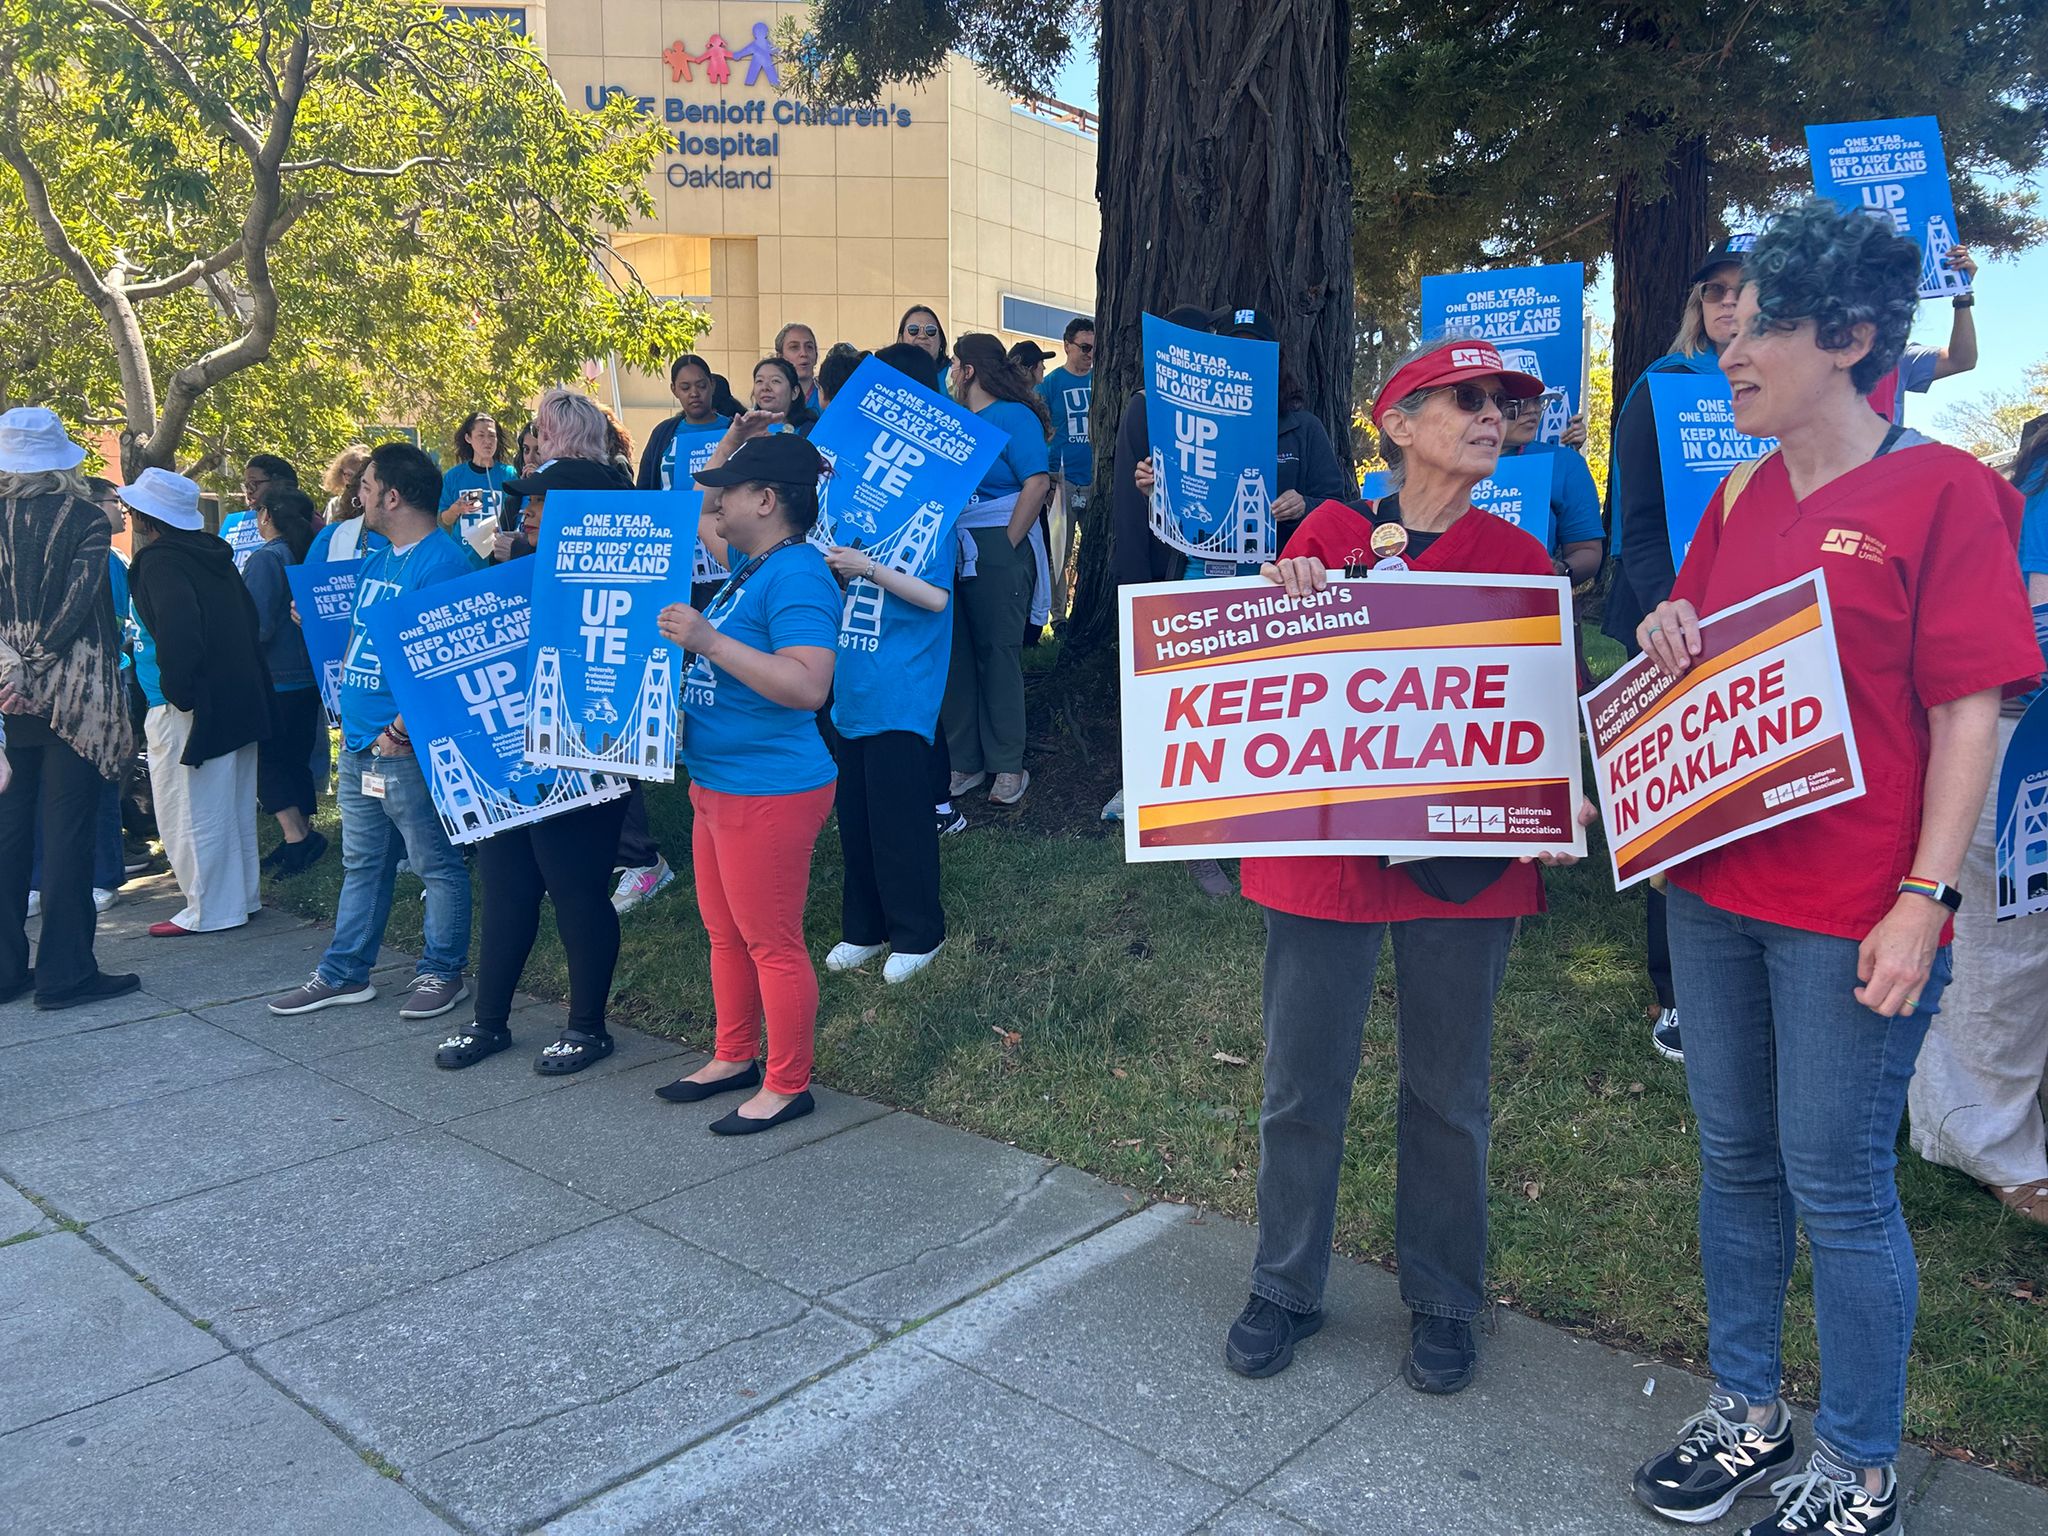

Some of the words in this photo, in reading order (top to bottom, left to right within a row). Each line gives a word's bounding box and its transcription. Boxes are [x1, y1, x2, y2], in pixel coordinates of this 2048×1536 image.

[585, 85, 656, 122] UF
[665, 98, 765, 124] Benioff
[1844, 137, 1868, 147] ONE
[1870, 134, 1904, 144] YEAR.
[1849, 145, 1881, 154] BRIDGE
[1830, 156, 1859, 167] KEEP
[1861, 153, 1892, 164] KIDS'
[1894, 150, 1925, 161] CARE
[1832, 166, 1848, 178] IN
[1851, 159, 1927, 176] OAKLAND
[667, 164, 772, 189] Oakland
[1861, 184, 1905, 209] UP
[1446, 303, 1468, 313] ONE
[1471, 300, 1509, 310] BRIDGE
[1512, 297, 1534, 307] TOO
[1536, 295, 1560, 305] FAR.
[1466, 291, 1495, 303] ONE
[1499, 286, 1540, 300] YEAR.
[1445, 314, 1481, 328] KEEP
[1485, 310, 1520, 324] KIDS'
[1523, 306, 1561, 320] CARE
[1469, 318, 1561, 339] OAKLAND
[1155, 350, 1170, 363] ONE
[1171, 356, 1202, 373] BRIDGE
[1204, 365, 1225, 378] TOO
[1227, 370, 1252, 381] FAR.
[1168, 344, 1191, 362] ONE
[1193, 351, 1231, 370] YEAR.
[1519, 356, 1534, 367] UP
[1155, 362, 1179, 380] KEEP
[1181, 373, 1211, 390] KIDS'
[1214, 381, 1253, 397] CARE
[1156, 374, 1168, 391] IN
[1170, 380, 1253, 411] OAKLAND
[874, 383, 895, 398] ONE
[896, 396, 934, 419] BRIDGE
[935, 417, 955, 431] TOO
[955, 429, 977, 445] FAR.
[897, 388, 925, 408] ONE
[927, 404, 963, 430] YEAR.
[1696, 399, 1727, 412] ONE
[866, 389, 902, 414] KEEP
[902, 410, 938, 432] KIDS'
[938, 430, 975, 455] CARE
[1678, 412, 1701, 423] ONE
[1703, 412, 1735, 423] BRIDG
[860, 397, 882, 414] IN
[883, 411, 969, 462] OAKLAND
[1175, 410, 1219, 448] UP
[1680, 427, 1716, 441] KEEP
[820, 445, 835, 457] OAK
[872, 430, 926, 468] UP
[1682, 441, 1703, 459] IN
[1175, 440, 1217, 480] TE
[861, 452, 913, 498] TE
[1243, 468, 1259, 478] SF
[1471, 490, 1491, 500] OO
[1493, 487, 1522, 499] FAR.
[928, 500, 944, 512] SF
[582, 514, 611, 527] ONE
[614, 514, 654, 528] YEAR.
[561, 526, 583, 536] ONE
[585, 527, 623, 537] BRIDGE
[625, 527, 647, 538] TOO
[649, 528, 673, 538] FAR.
[557, 541, 592, 554] KEEP
[595, 541, 632, 555] KIDS'
[634, 543, 672, 557] CARE
[556, 554, 575, 571] IN
[579, 555, 670, 574] OAKLAND
[312, 586, 333, 594] ONE
[335, 581, 357, 592] BRID
[329, 574, 355, 585] ONE
[314, 592, 347, 605] KEEP
[316, 602, 335, 615] IN
[417, 605, 452, 625] ONE
[453, 591, 502, 613] YEAR.
[581, 588, 633, 627] UP
[399, 626, 426, 641] ONE
[426, 612, 472, 632] BRIDGE
[472, 604, 498, 618] TOO
[500, 595, 527, 610] FAR.
[1152, 608, 1219, 637] UCSF
[1226, 586, 1353, 622] Children's
[403, 635, 444, 658] KEEP
[447, 620, 488, 644] KIDS'
[1156, 624, 1259, 661] Hospital
[1265, 606, 1370, 638] Oakland
[542, 646, 556, 654] OAK
[579, 626, 629, 665] TE
[652, 648, 668, 660] SF
[407, 652, 433, 672] IN
[349, 673, 381, 690] 9119
[455, 661, 517, 704] UP
[1163, 671, 1329, 732] KEEP
[1346, 664, 1510, 713] CARE
[467, 691, 525, 735] TE
[1595, 698, 1620, 729] UCSF
[1599, 701, 1639, 746] Hospital
[1609, 722, 1674, 796] KEEP
[1680, 658, 1787, 744] CARE
[431, 737, 448, 747] OAK
[1160, 738, 1226, 788] IN
[1243, 721, 1546, 779] OAKLAND
[1613, 799, 1640, 837] IN
[1645, 696, 1824, 814] OAKLAND
[1508, 806, 1552, 816] California
[1508, 816, 1540, 825] Nurses
[1509, 825, 1562, 835] Association
